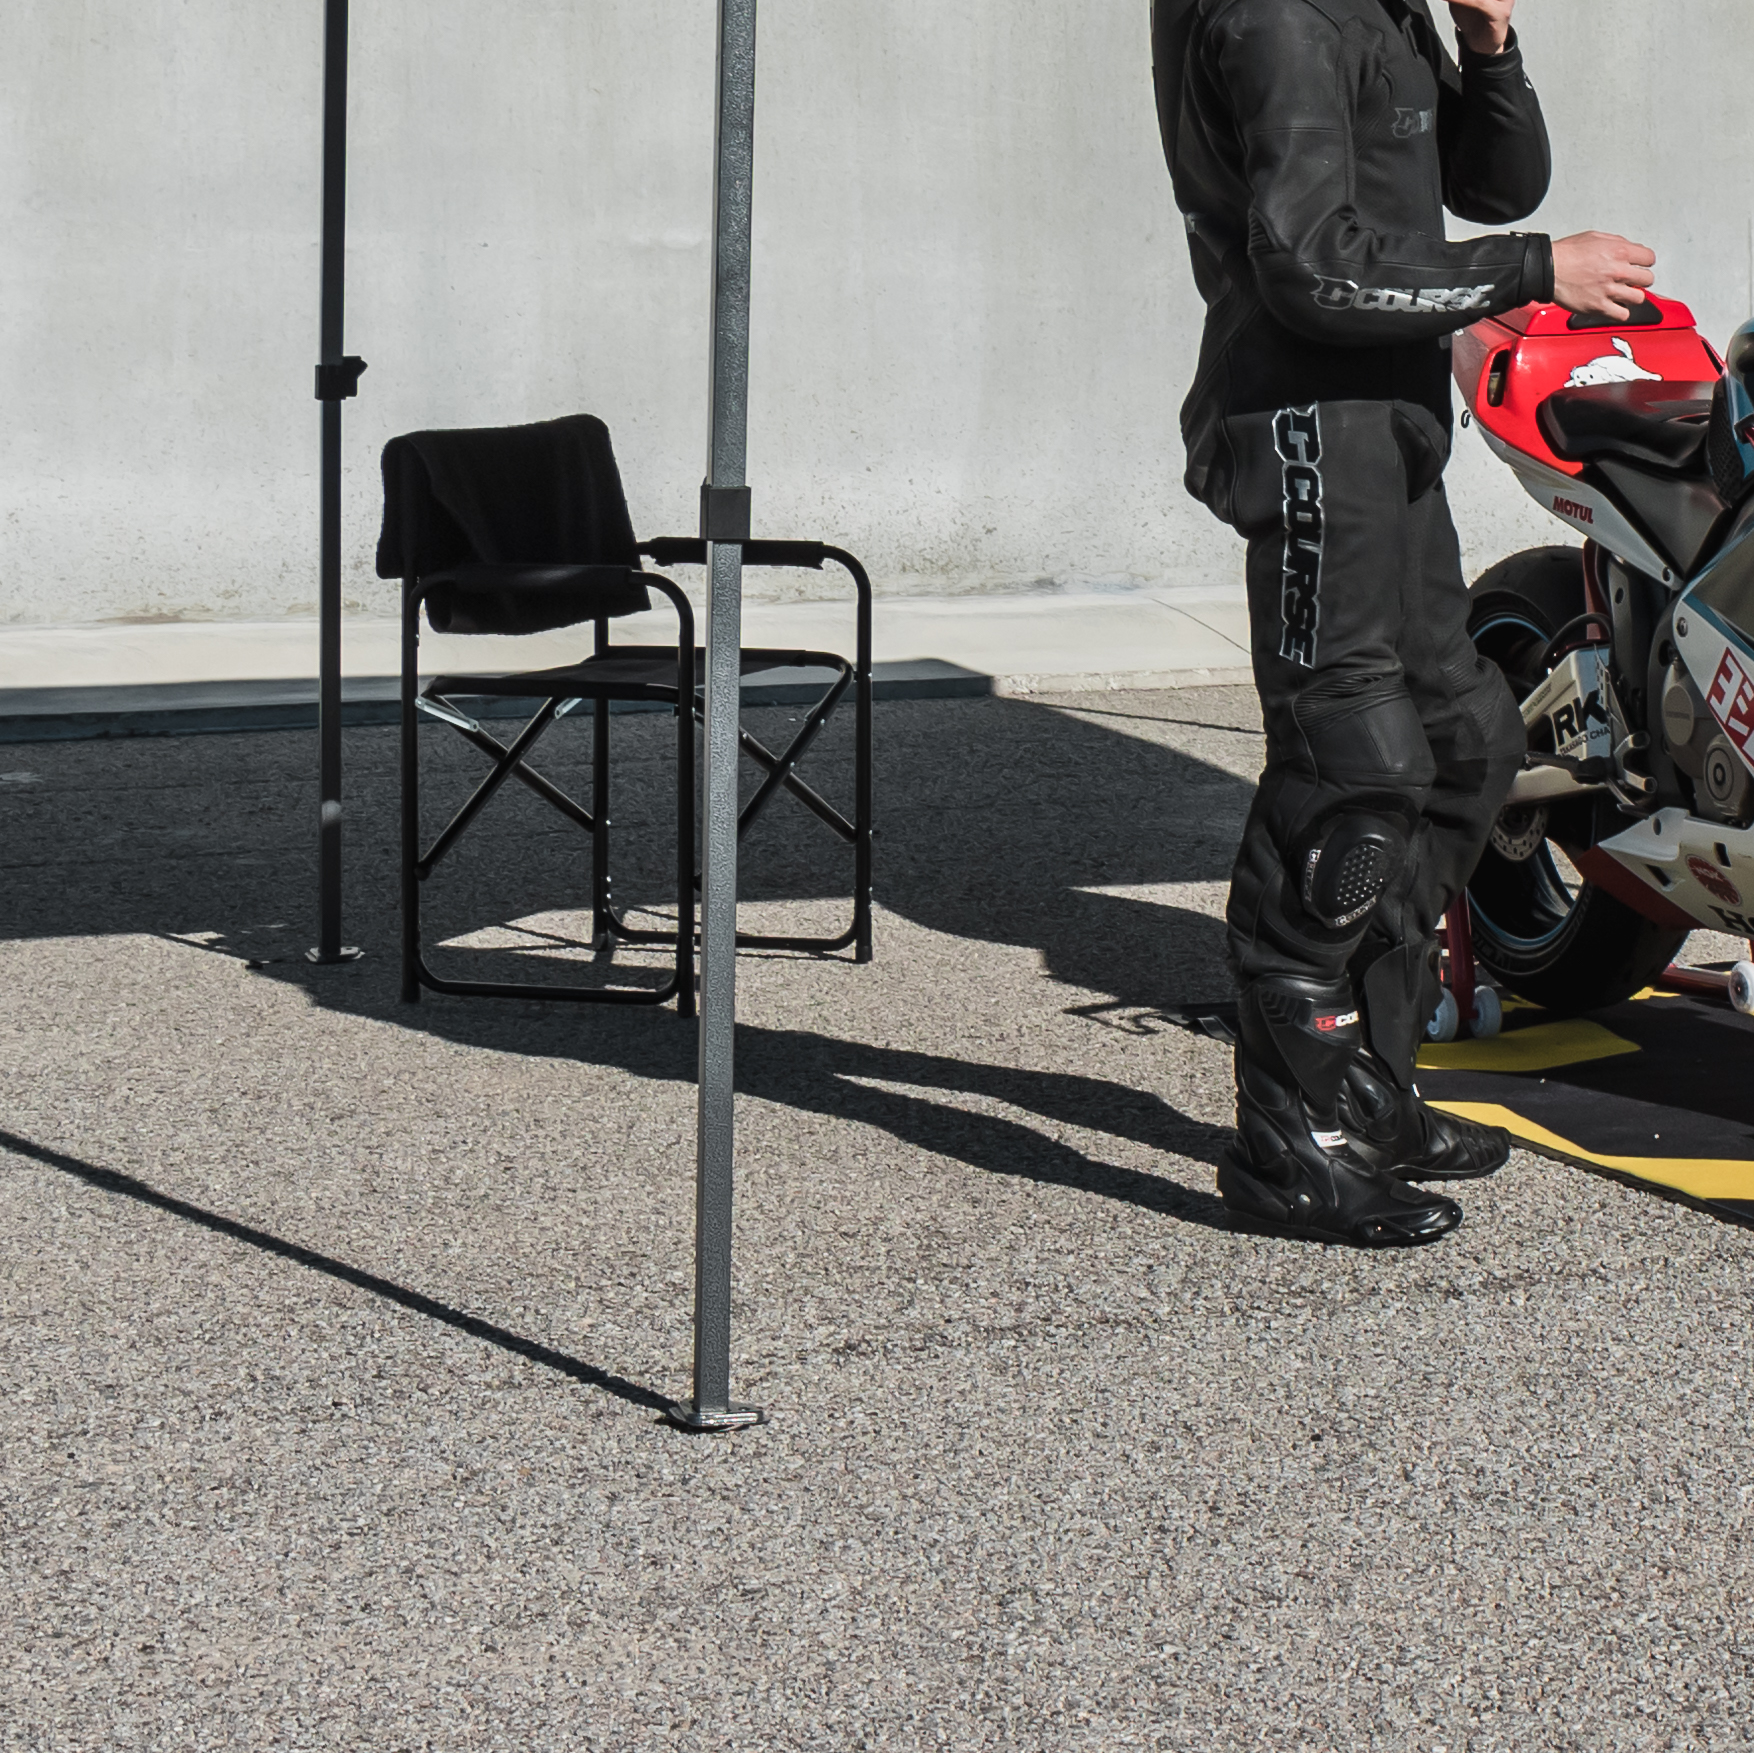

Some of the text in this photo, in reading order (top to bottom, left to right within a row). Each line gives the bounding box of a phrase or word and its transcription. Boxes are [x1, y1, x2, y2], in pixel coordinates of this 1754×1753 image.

[1553, 495, 1594, 524] MOTUL
[1552, 689, 1609, 747] RK
[1590, 725, 1611, 741] CHA
